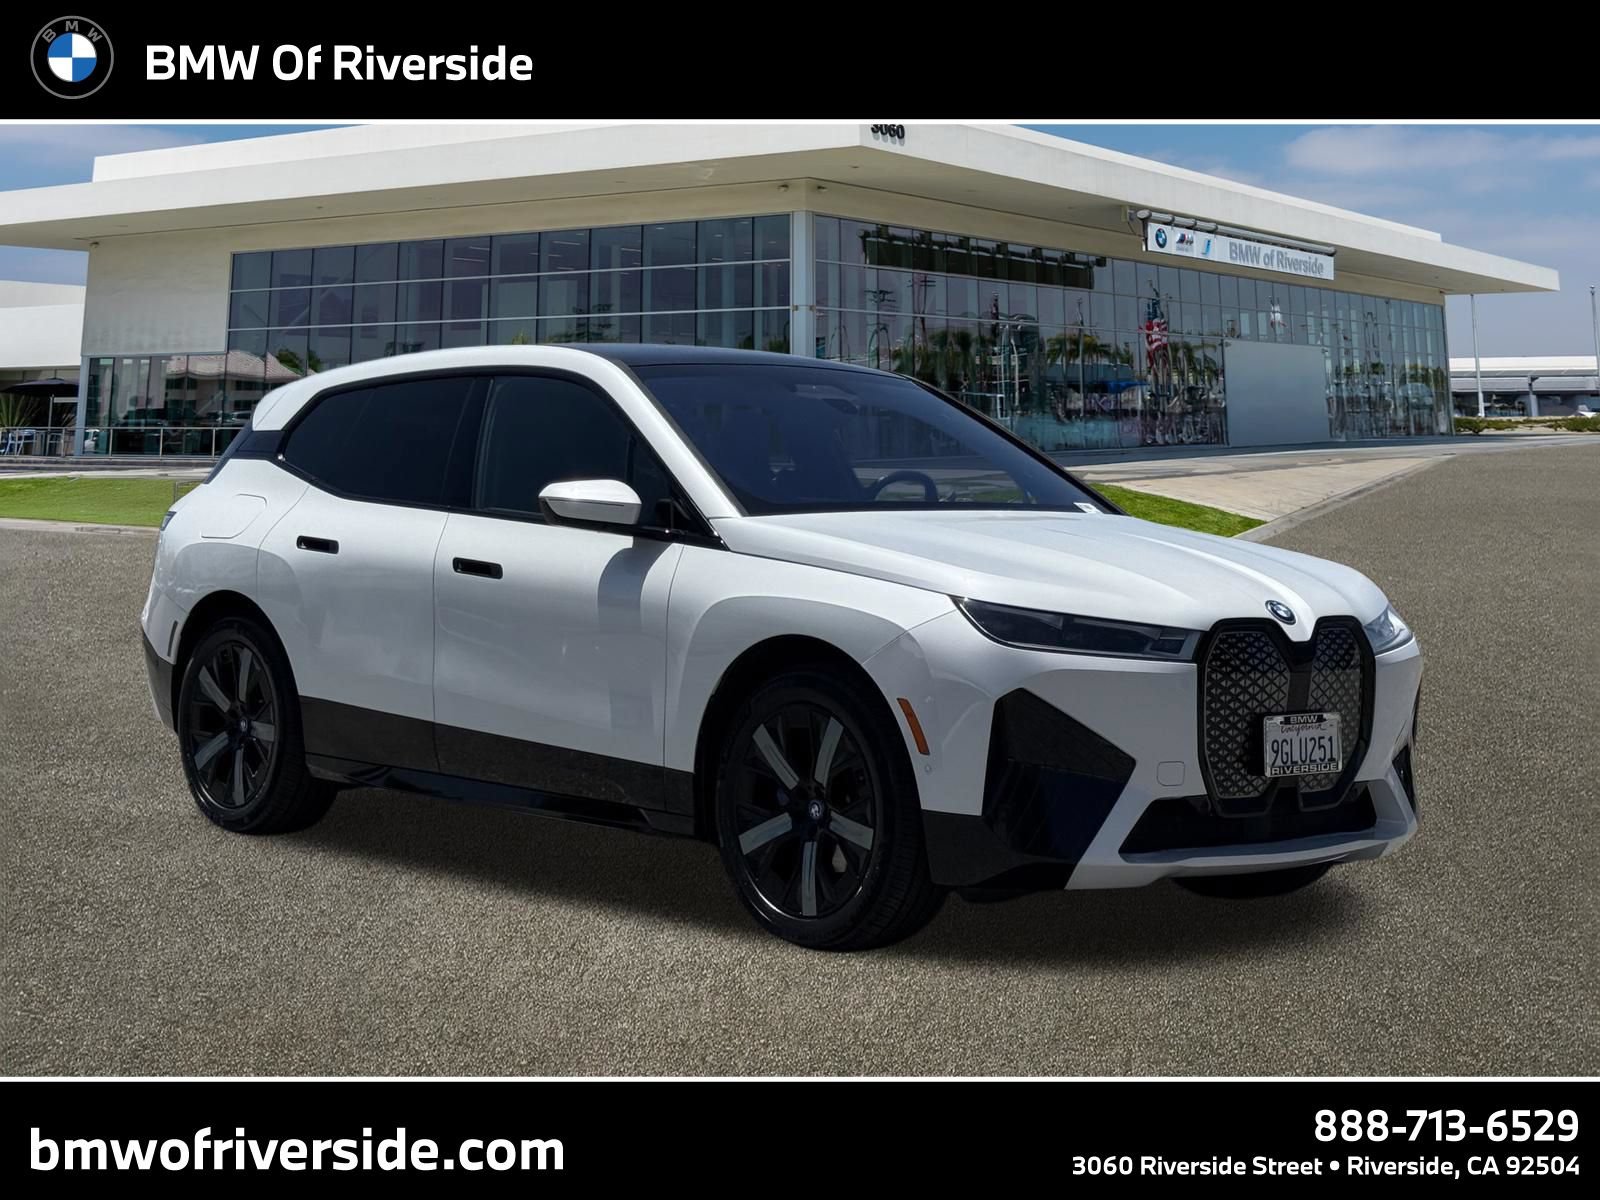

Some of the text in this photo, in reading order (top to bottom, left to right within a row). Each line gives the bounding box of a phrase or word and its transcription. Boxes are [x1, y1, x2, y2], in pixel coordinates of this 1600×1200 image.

[1229, 241, 1261, 265] BMW
[1263, 249, 1275, 268] of
[1276, 251, 1325, 275] Riverside
[1290, 715, 1318, 724] BMW
[1271, 735, 1337, 767] 9GLU251
[1271, 762, 1337, 776] RIVERSIDE
